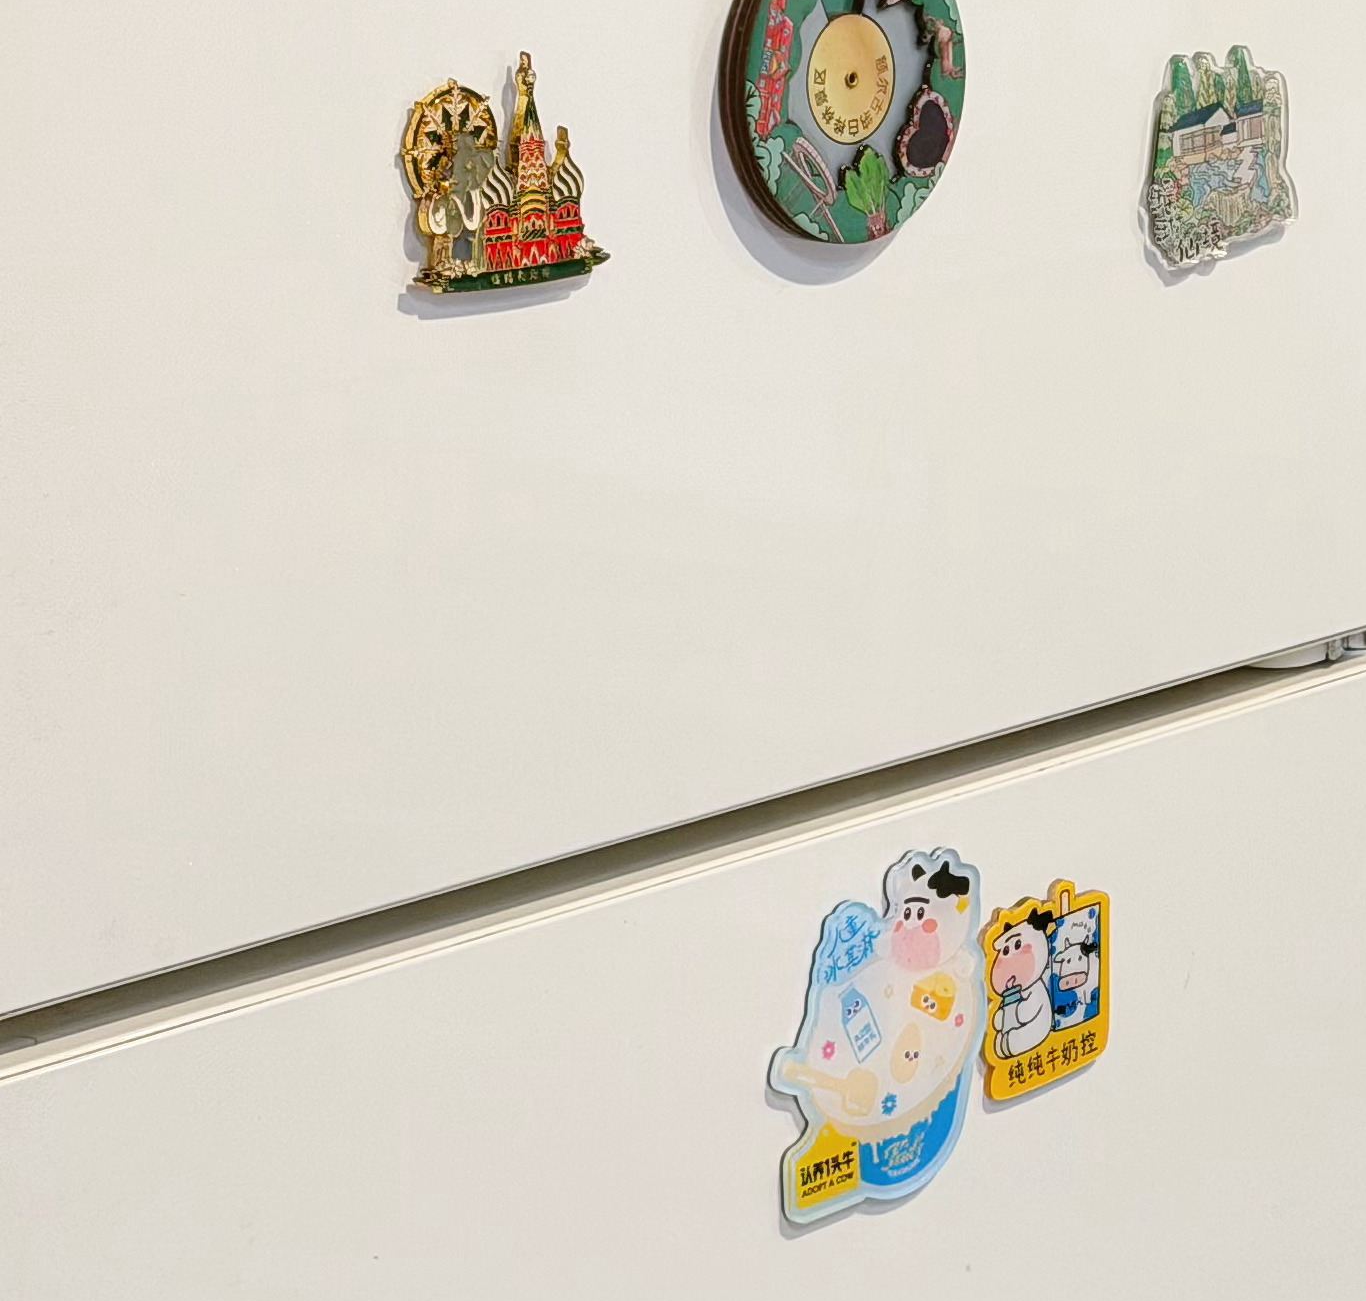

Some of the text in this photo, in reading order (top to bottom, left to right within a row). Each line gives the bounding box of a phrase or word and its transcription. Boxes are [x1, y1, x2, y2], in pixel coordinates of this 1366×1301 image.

[1008, 1030, 1099, 1088] 纯纯牛奶控
[801, 1181, 827, 1198] ADOPT
[836, 1171, 855, 1186] COW
